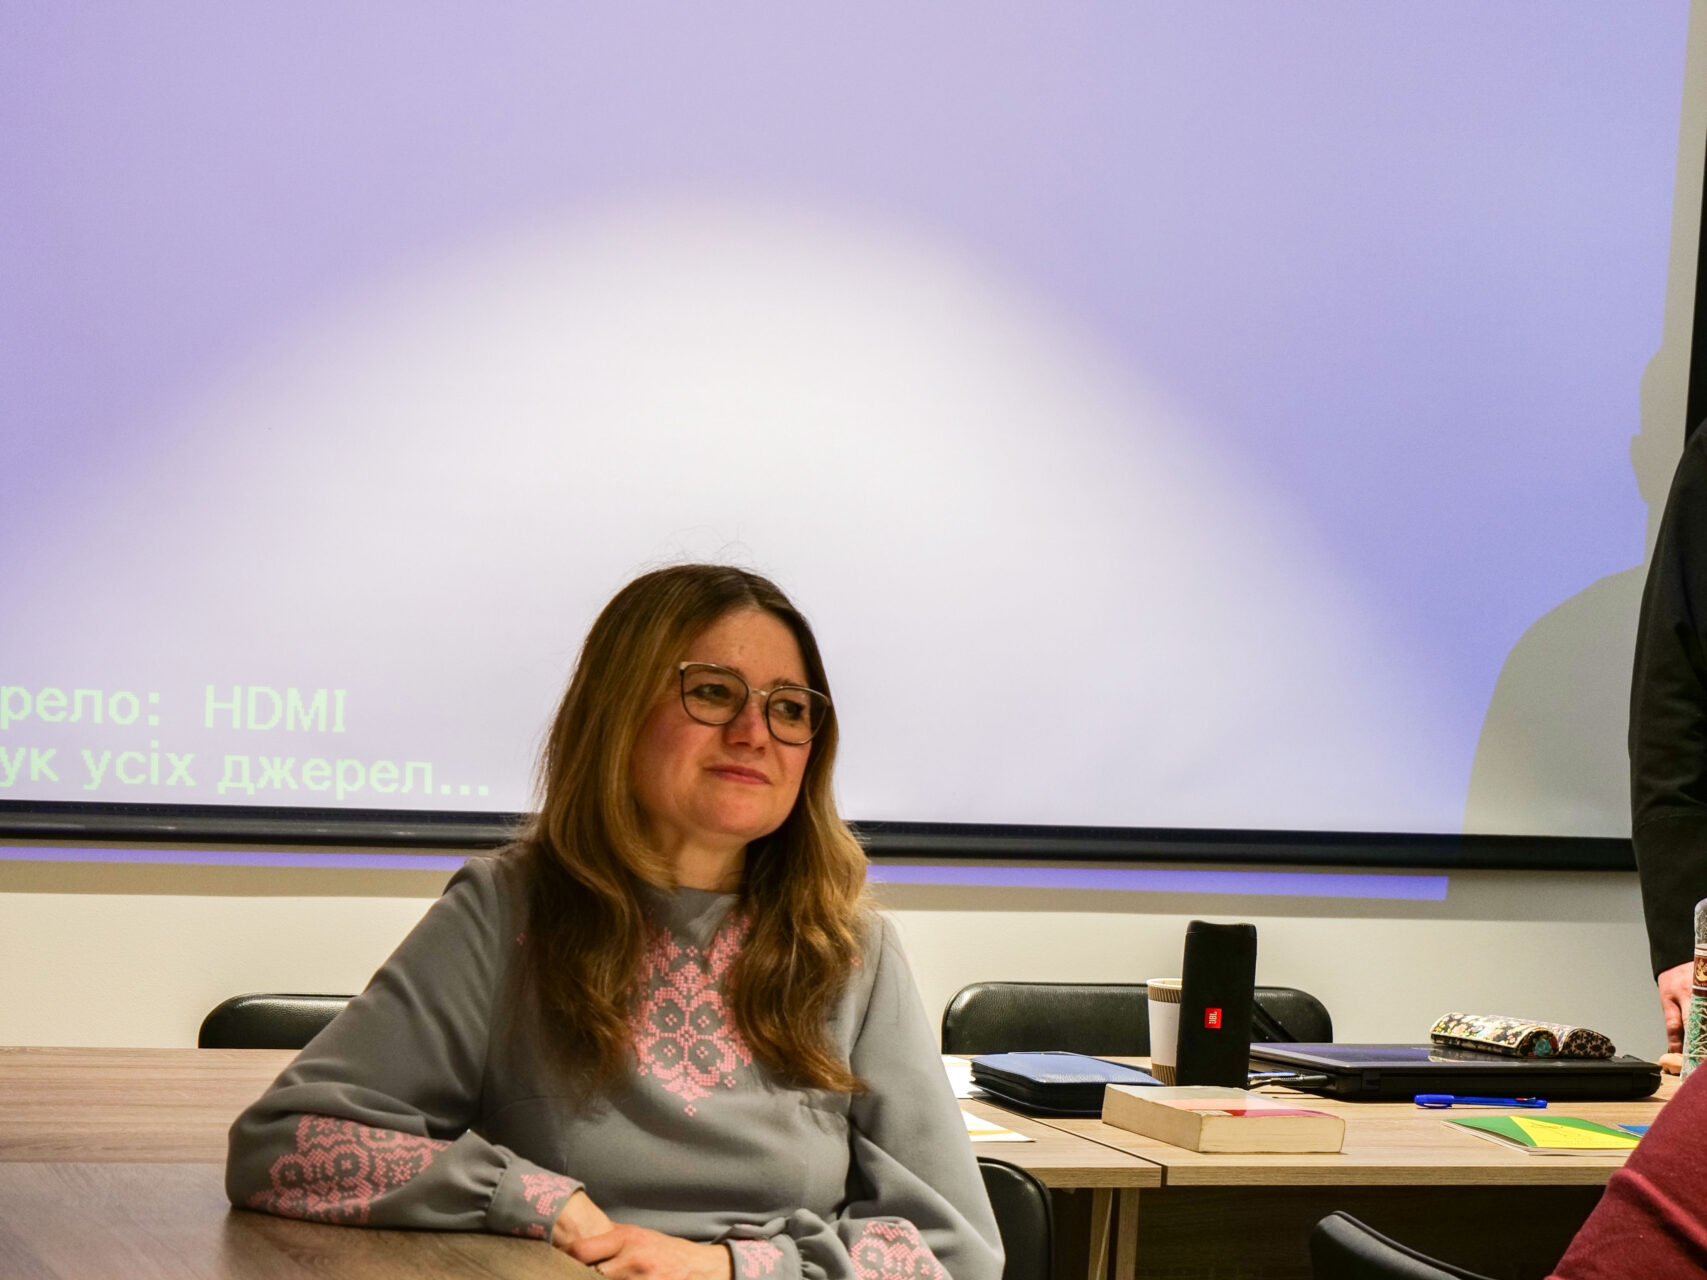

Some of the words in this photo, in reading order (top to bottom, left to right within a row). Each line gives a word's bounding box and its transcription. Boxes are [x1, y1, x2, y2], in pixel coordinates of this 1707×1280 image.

[206, 686, 347, 732] HDMI
[80, 740, 197, 790] усіх
[217, 754, 489, 800] джерел...
[1208, 1011, 1218, 1025] JBL
